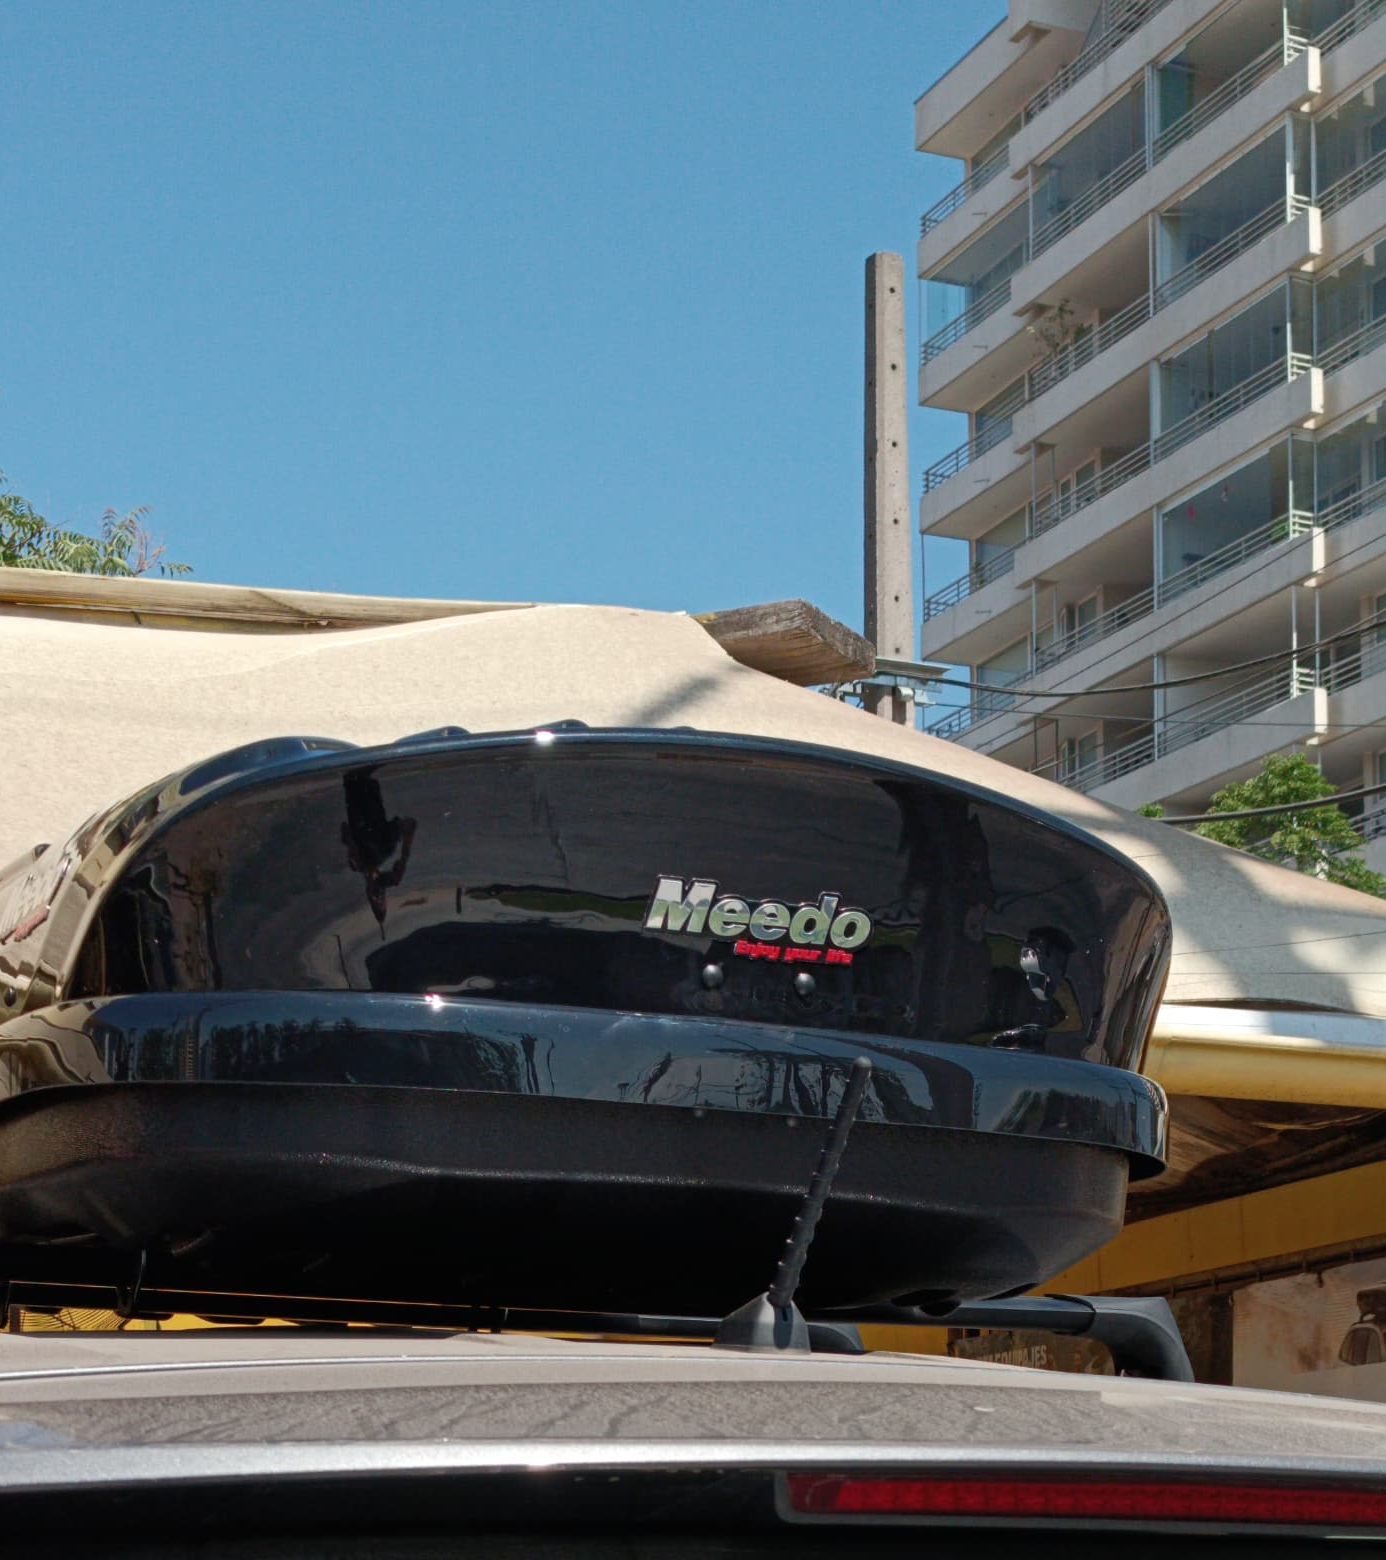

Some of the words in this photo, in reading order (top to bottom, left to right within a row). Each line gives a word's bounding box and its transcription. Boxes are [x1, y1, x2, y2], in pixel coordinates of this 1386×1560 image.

[644, 876, 873, 950] Meedo
[734, 940, 781, 961] Enjoy
[784, 946, 821, 961] your
[825, 948, 853, 965] life
